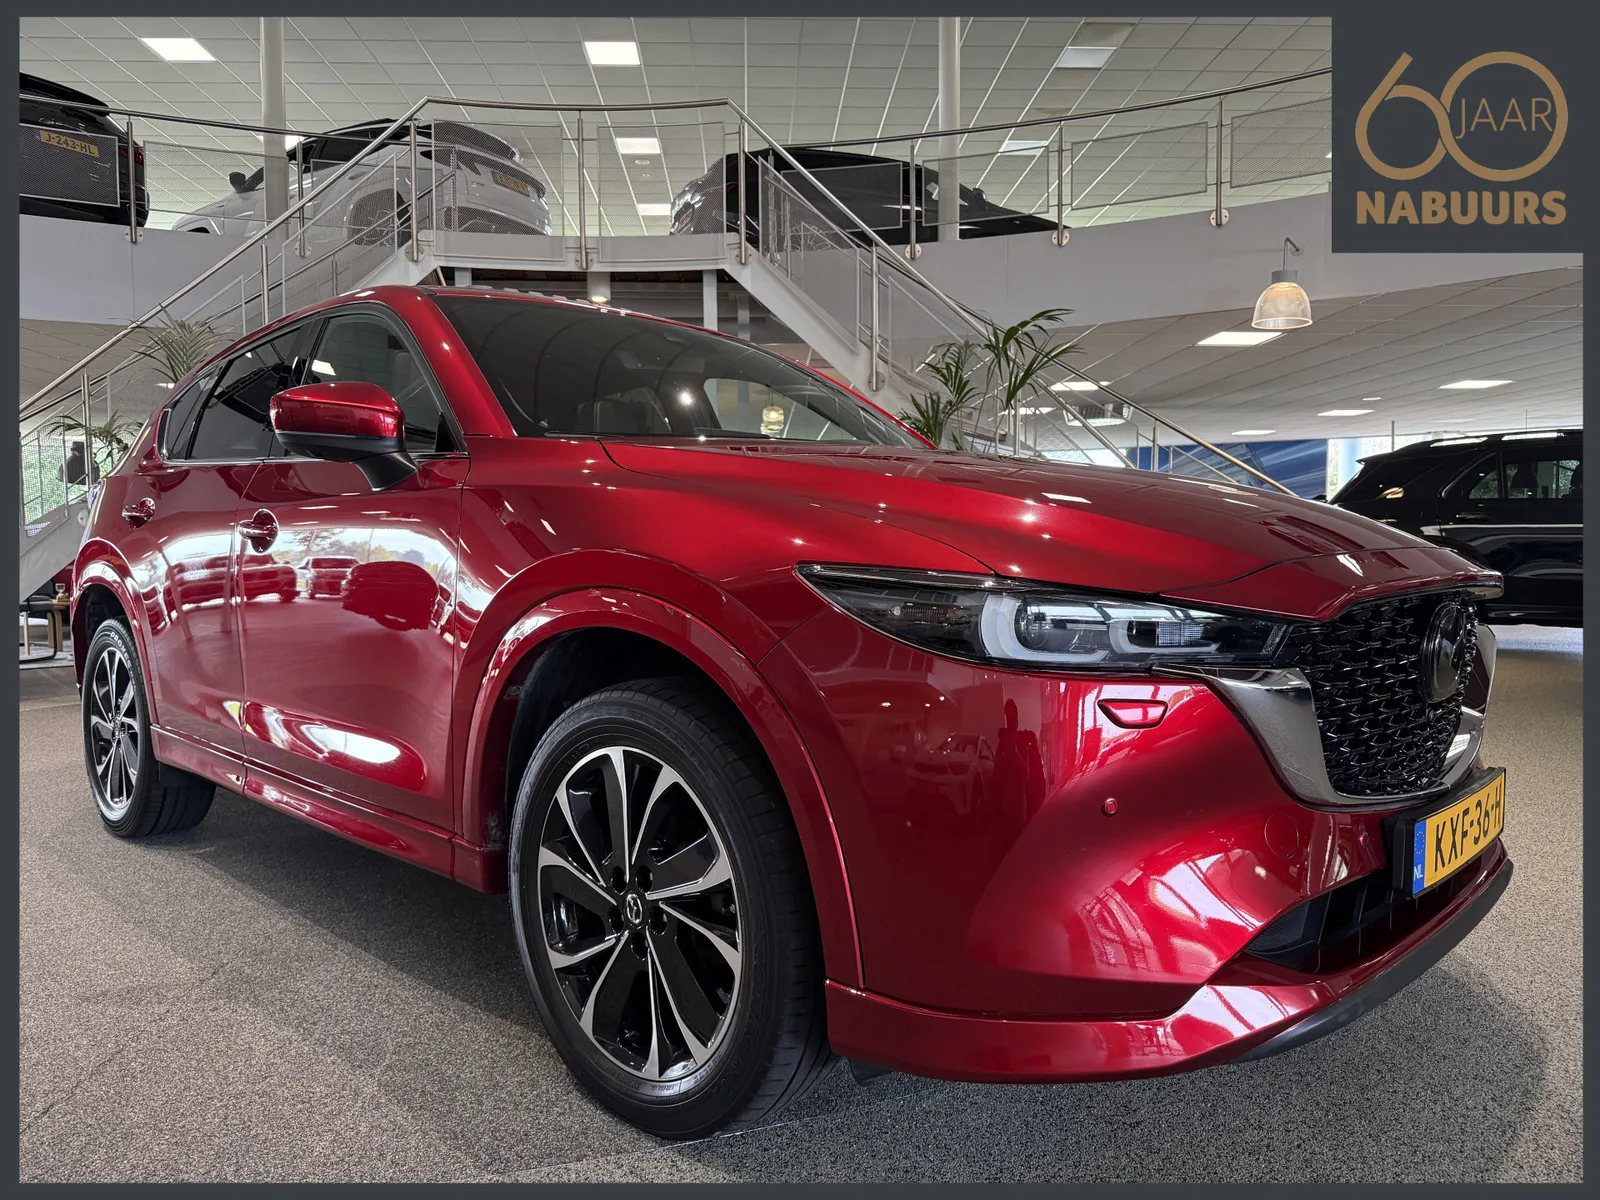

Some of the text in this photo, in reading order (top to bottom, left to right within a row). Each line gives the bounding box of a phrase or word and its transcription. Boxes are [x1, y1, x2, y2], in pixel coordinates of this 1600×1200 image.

[45, 132, 95, 155] J-243-HL
[1434, 782, 1502, 873] KXF-36-H
[1413, 863, 1424, 881] NL
